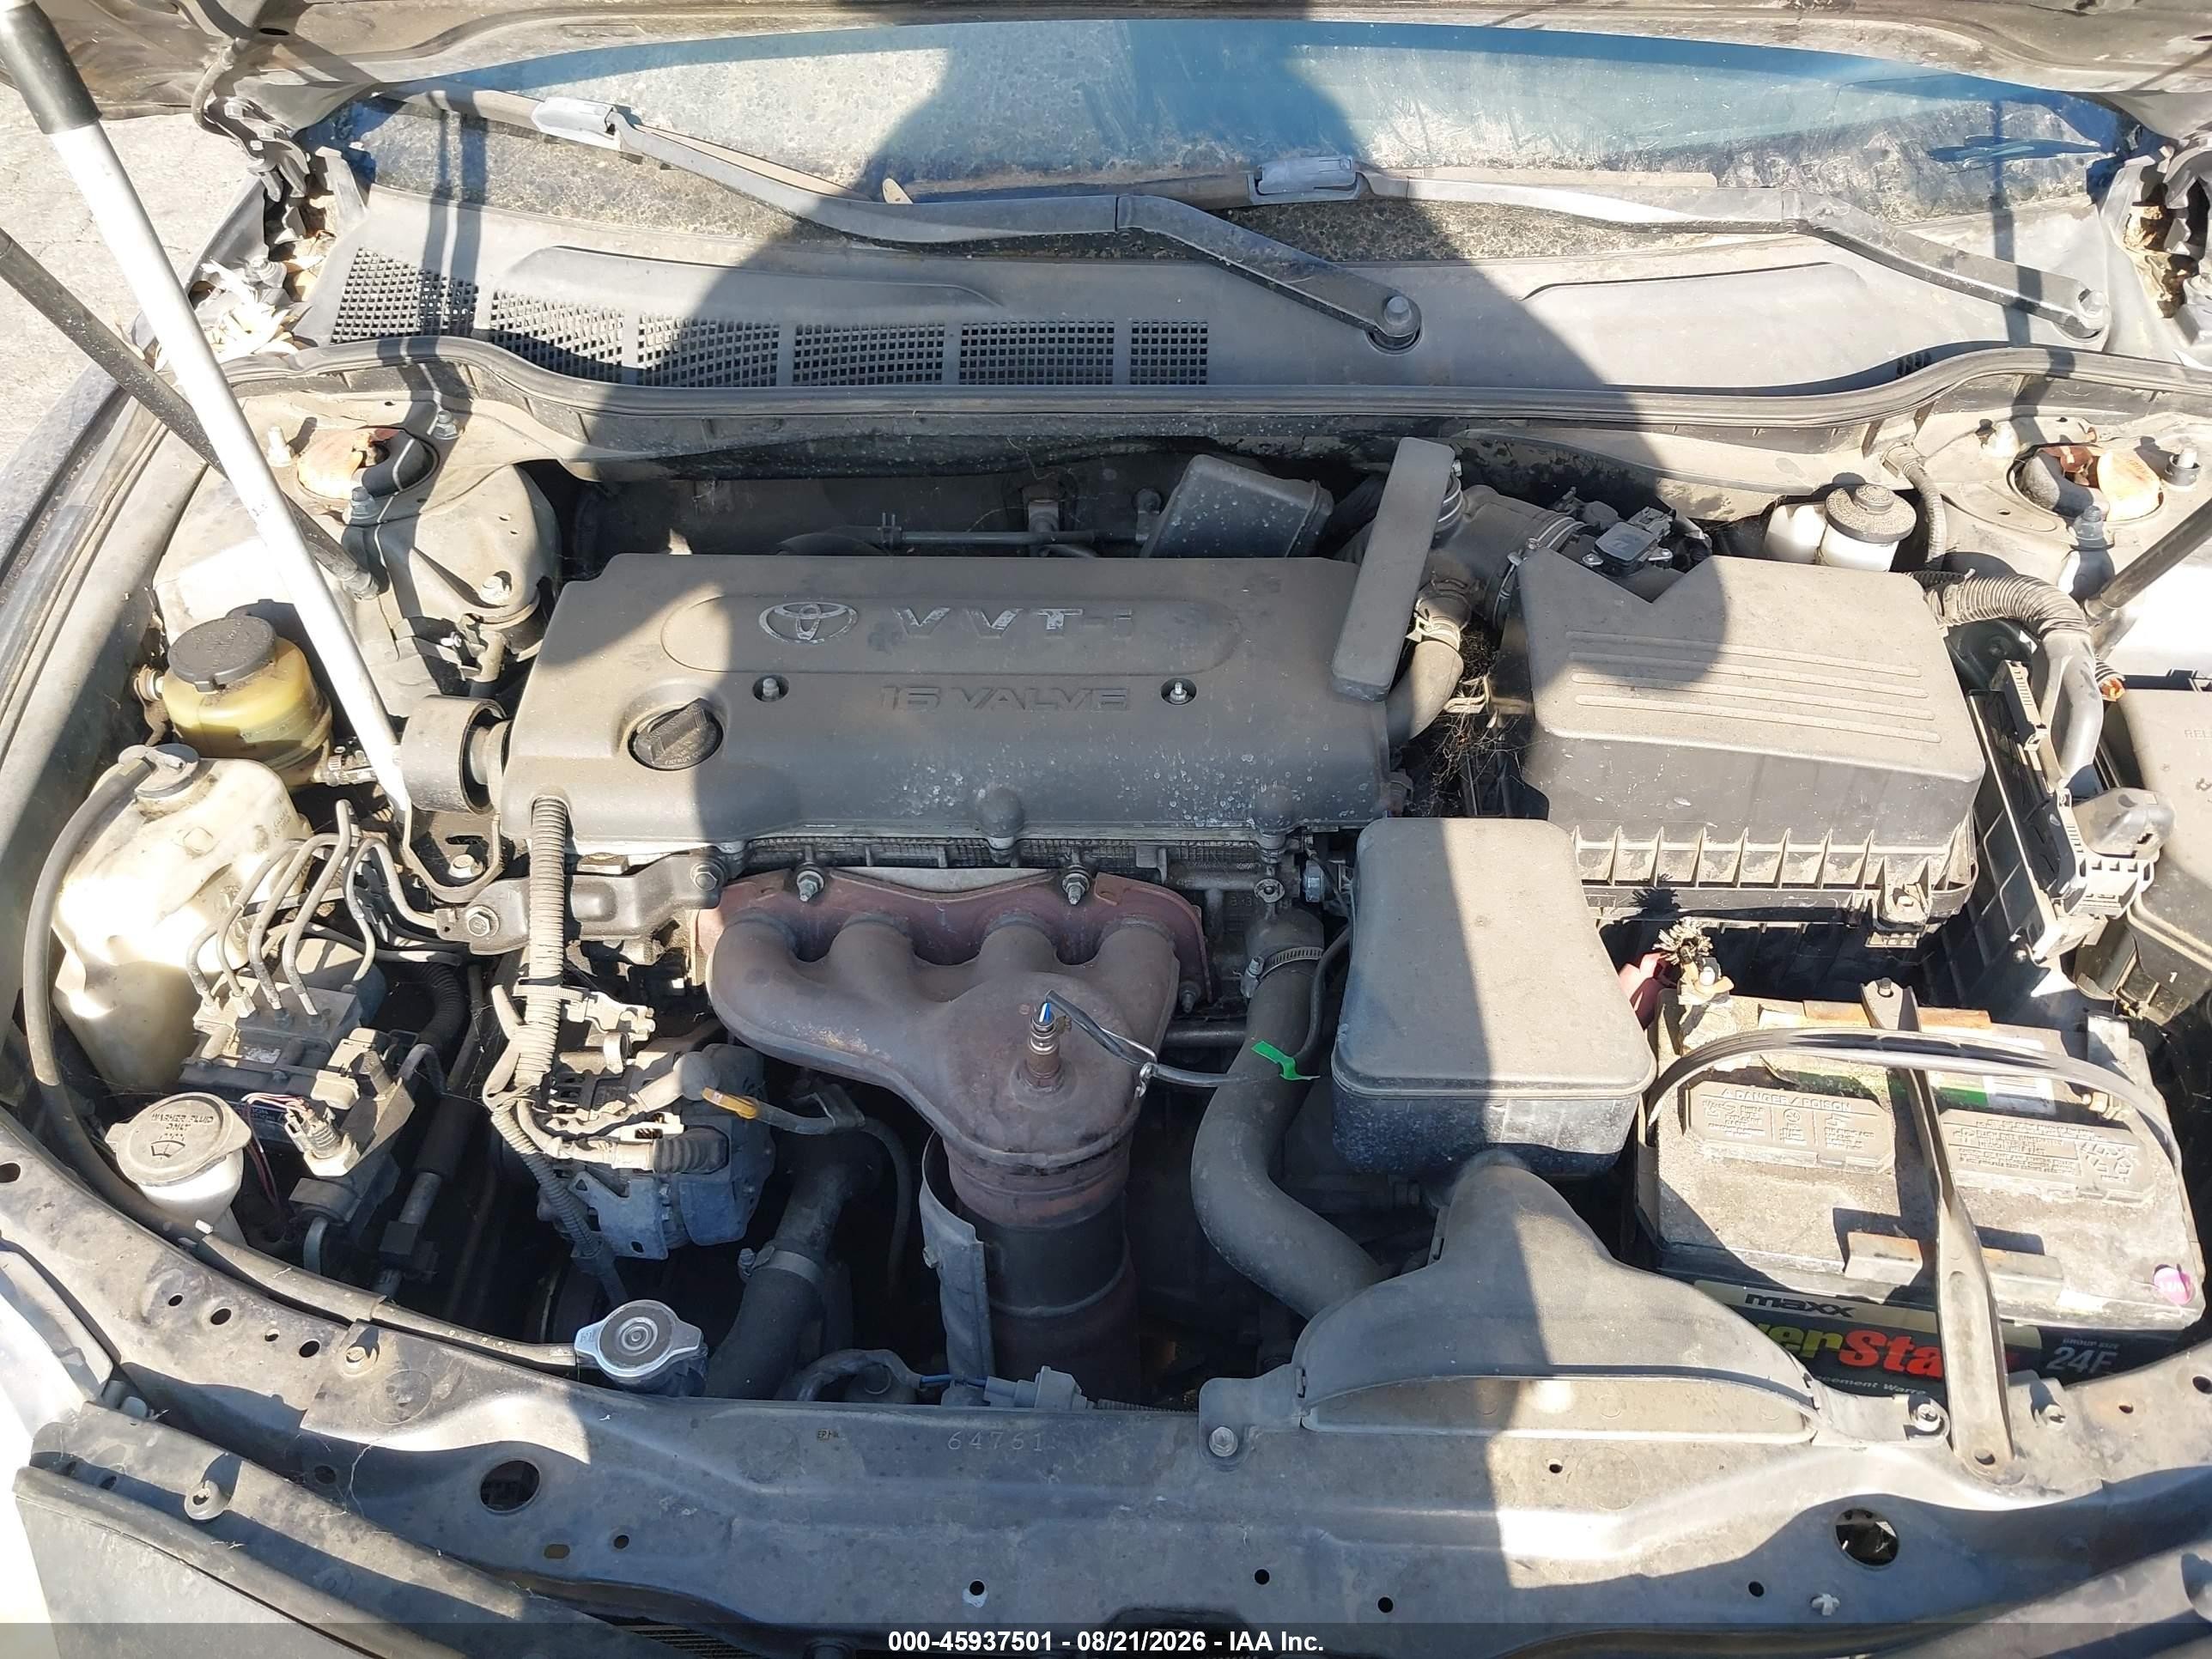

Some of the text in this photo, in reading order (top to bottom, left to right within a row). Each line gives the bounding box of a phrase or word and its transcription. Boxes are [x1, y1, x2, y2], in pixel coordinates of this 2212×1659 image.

[880, 687, 1130, 710] 16 VALVE
[2169, 971, 2178, 983] 1
